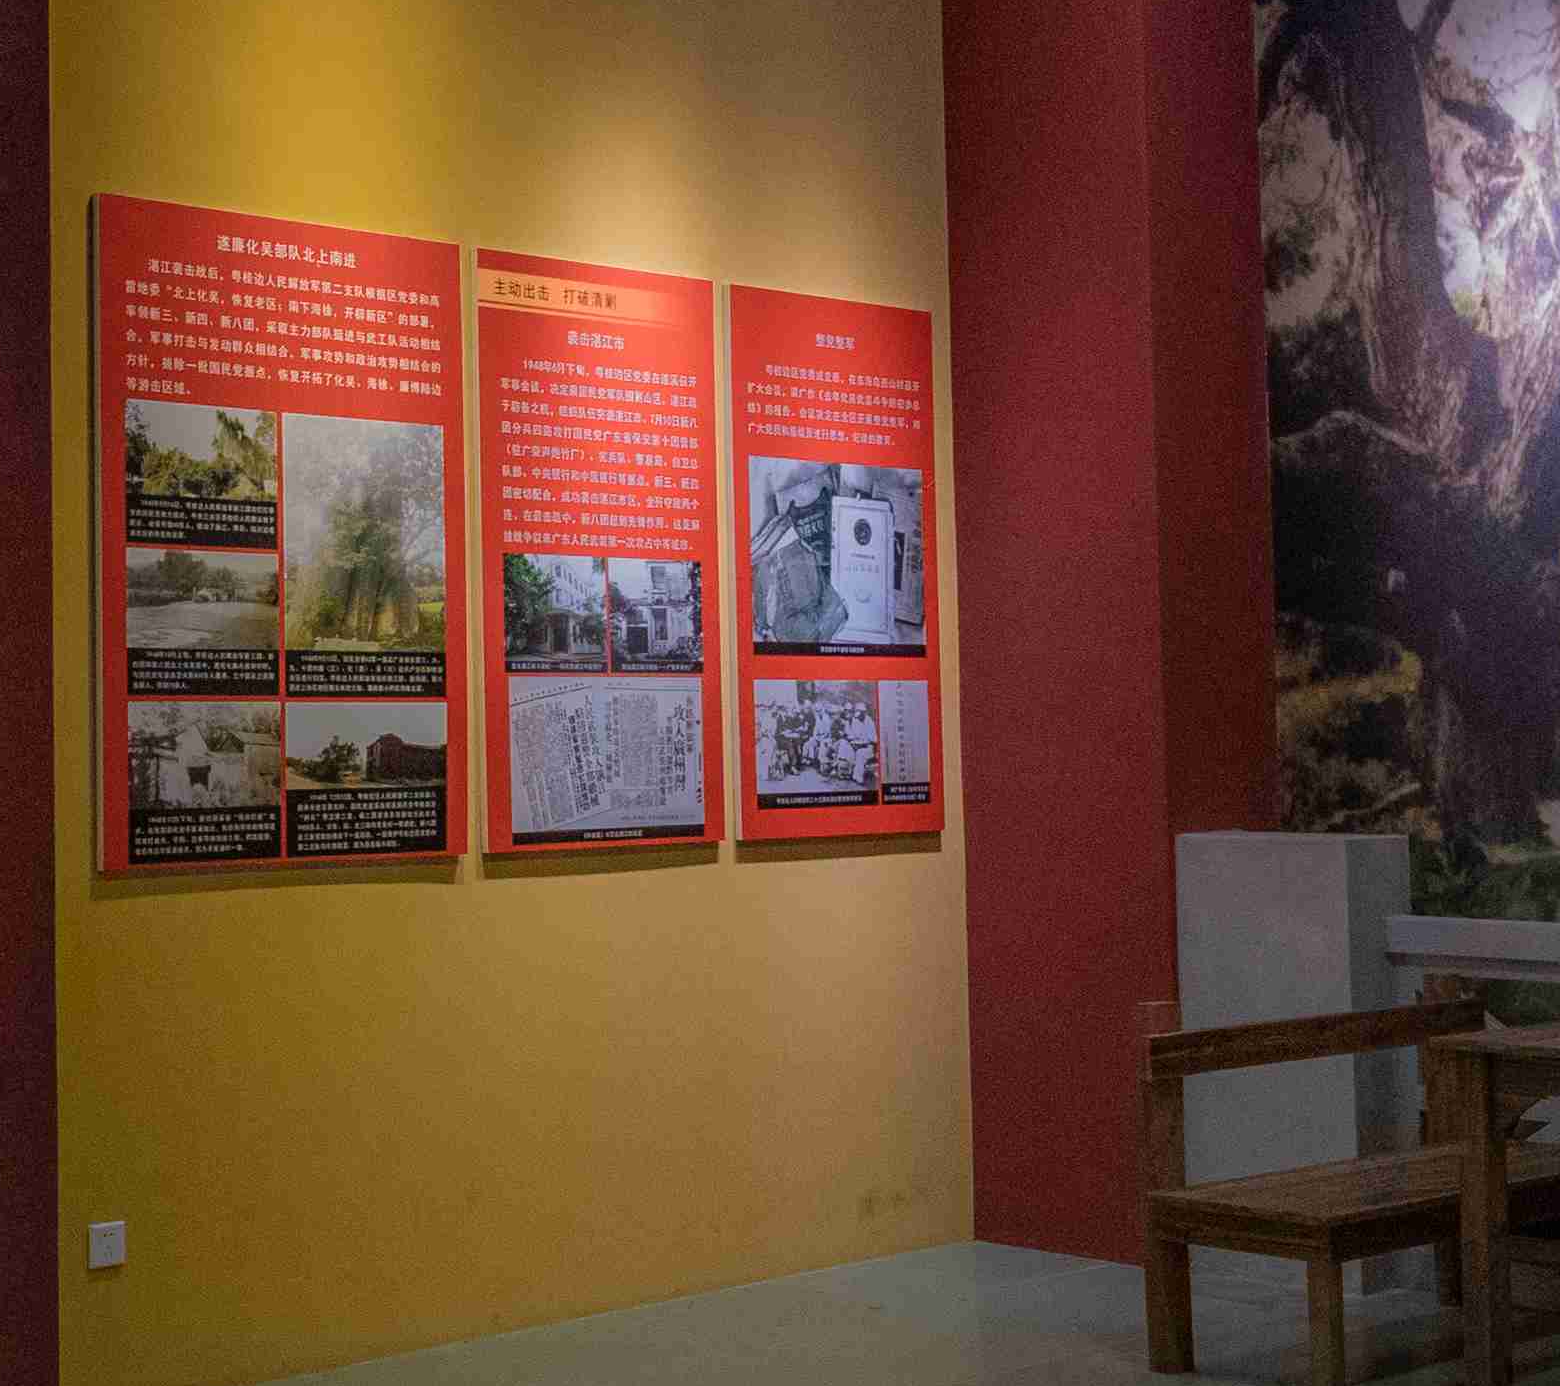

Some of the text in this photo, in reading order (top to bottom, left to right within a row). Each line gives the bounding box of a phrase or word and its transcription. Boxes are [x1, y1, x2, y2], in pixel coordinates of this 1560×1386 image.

[493, 276, 617, 312] 主动出击 打破清剿
